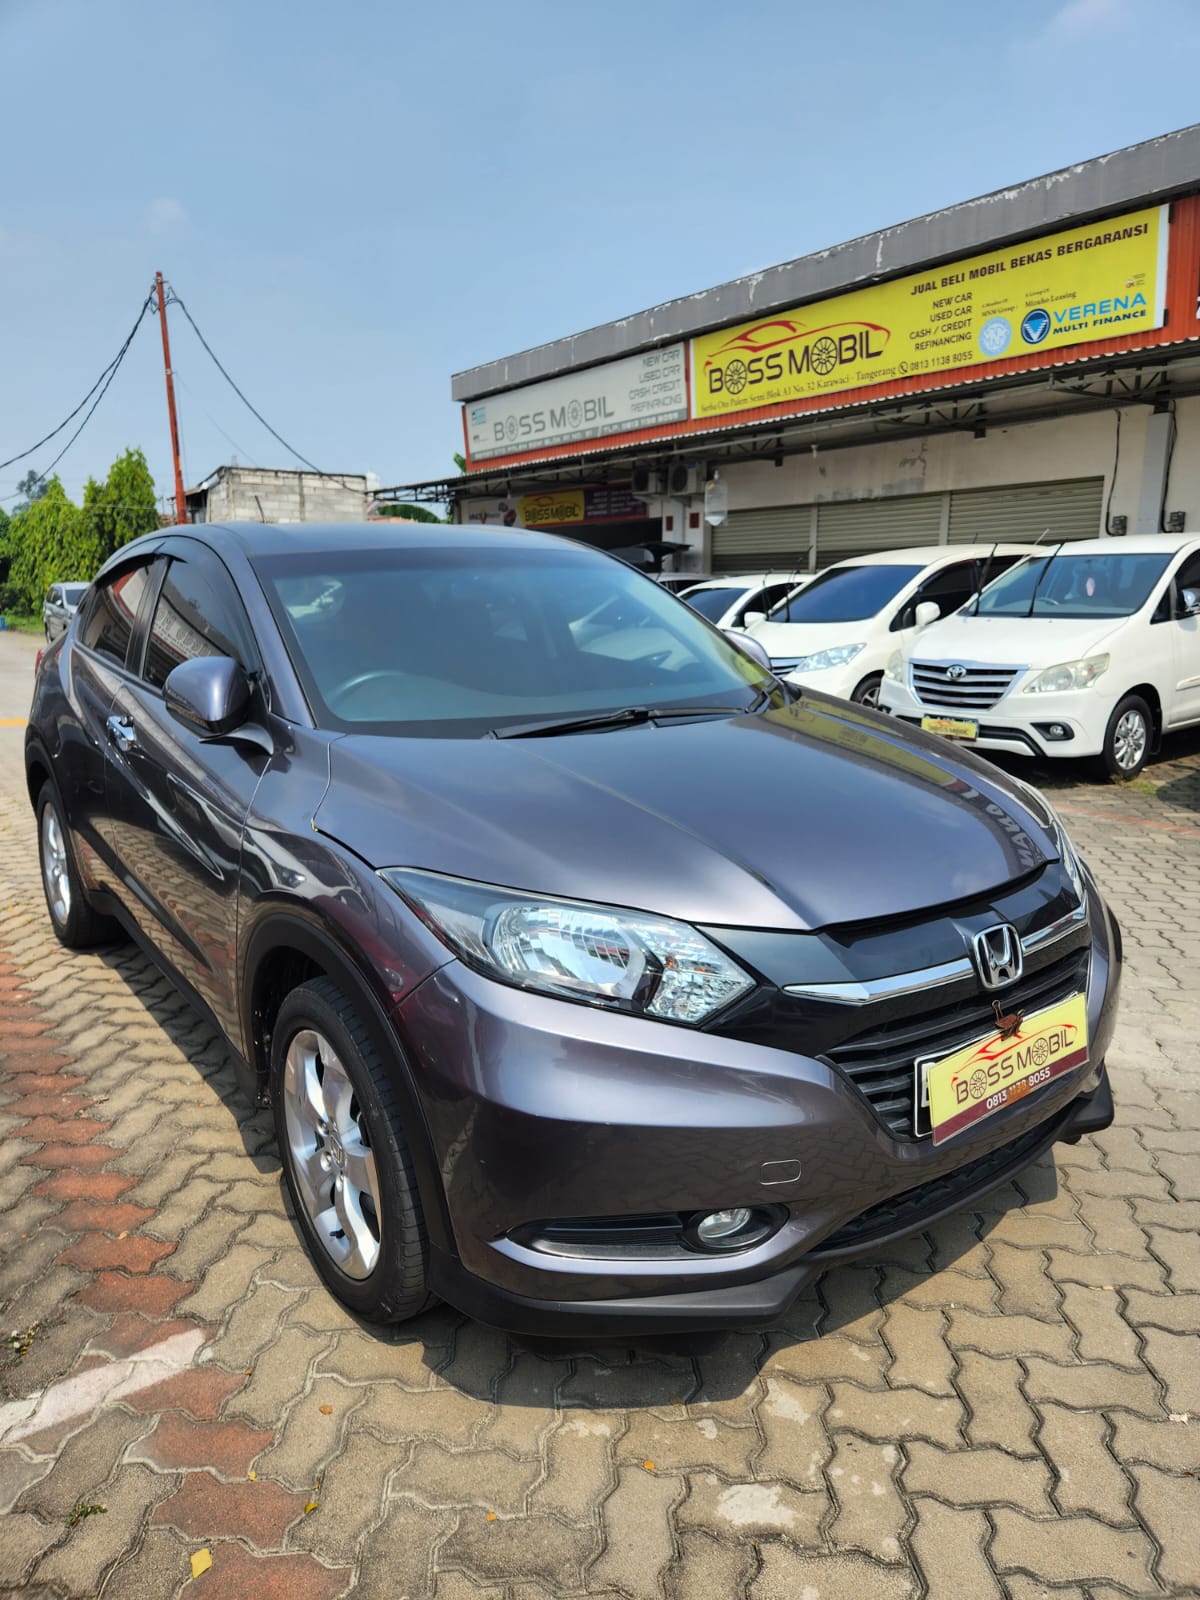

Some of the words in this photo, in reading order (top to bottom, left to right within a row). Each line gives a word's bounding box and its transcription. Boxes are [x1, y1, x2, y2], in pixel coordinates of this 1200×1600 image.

[911, 281, 937, 295] JUAL
[941, 272, 965, 288] BELI
[969, 262, 1006, 280] MOBIL
[1010, 249, 1052, 268] BEKAS
[1057, 223, 1148, 256] BERGARANSI
[932, 295, 954, 308] NEW
[955, 292, 973, 303] CAR
[1053, 292, 1147, 323] VERENA
[930, 310, 952, 322] USED
[954, 306, 972, 318] CAR
[1052, 322, 1089, 335] MULTI
[1092, 309, 1147, 327] FINANCE
[909, 328, 931, 340] CASH
[941, 319, 972, 334] CREDIT
[914, 332, 972, 351] REFINANCING
[709, 352, 783, 395] BOSS
[788, 330, 884, 376] MOBIL
[856, 367, 896, 382] Tangerang
[909, 360, 929, 371] 0813
[931, 356, 951, 367] 1138
[952, 353, 973, 364] 8055
[493, 411, 546, 442] BOSS
[550, 396, 615, 429] MOBIL
[956, 1054, 1014, 1105] BOSS
[1016, 1028, 1074, 1072] MOBIL
[986, 1090, 1008, 1110] 0813
[1029, 1067, 1051, 1087] 8055
